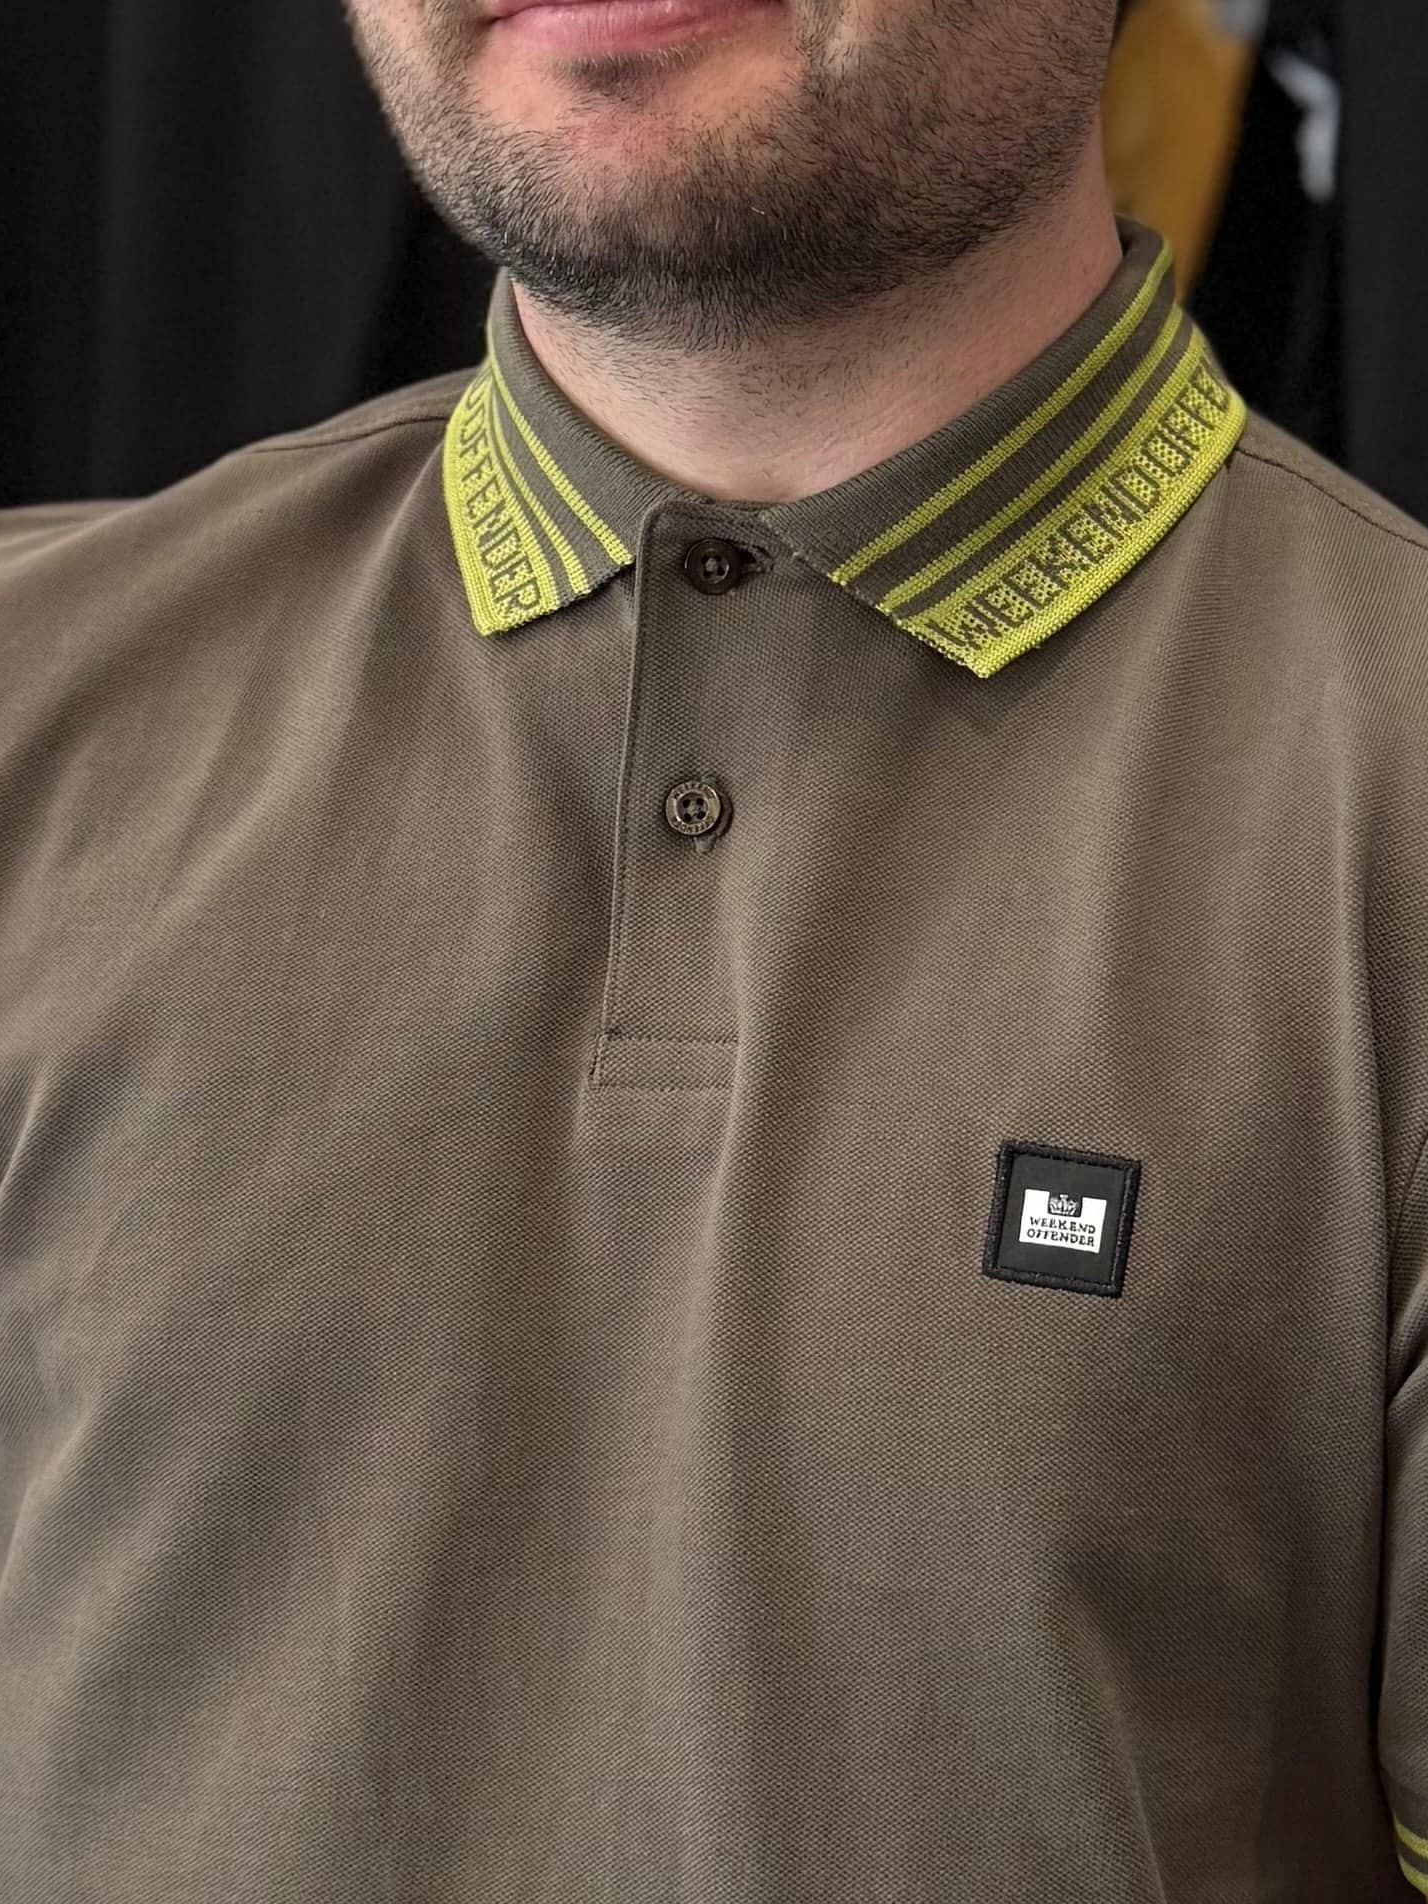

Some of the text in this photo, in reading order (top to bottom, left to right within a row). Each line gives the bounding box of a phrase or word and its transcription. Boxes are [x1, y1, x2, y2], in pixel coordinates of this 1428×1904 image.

[1138, 356, 1230, 477] OFFE
[460, 402, 540, 616] OFFENDER
[1026, 1228, 1095, 1247] OFFENDER
[1029, 1217, 1096, 1234] WEEKEND
